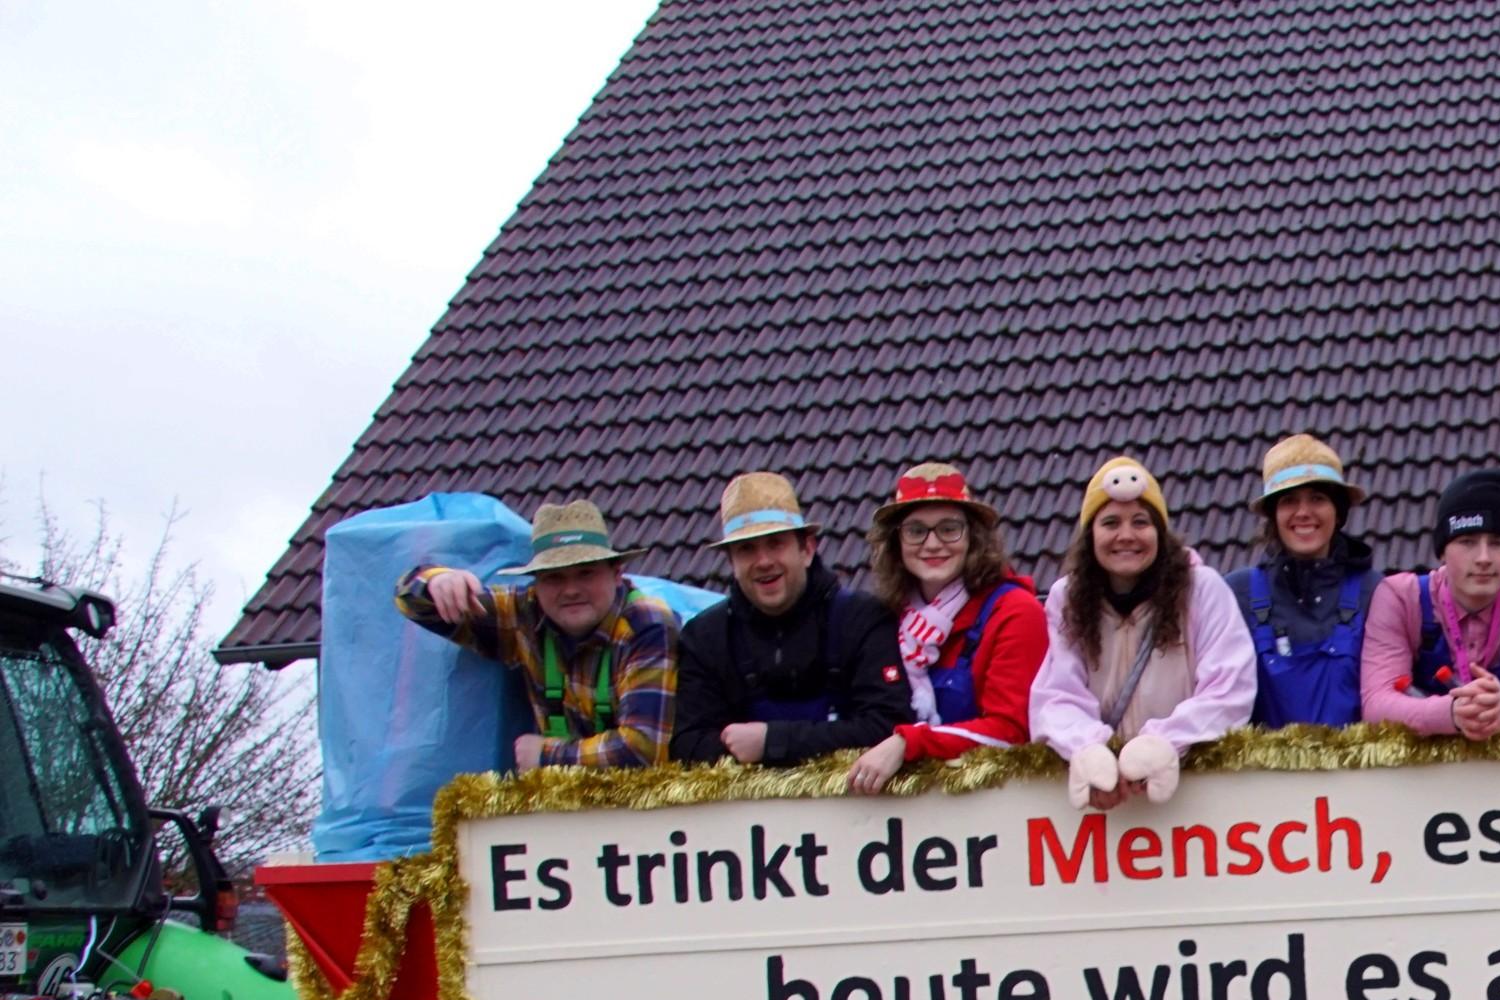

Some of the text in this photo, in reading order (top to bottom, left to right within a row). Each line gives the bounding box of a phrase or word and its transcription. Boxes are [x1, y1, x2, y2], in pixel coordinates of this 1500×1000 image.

[490, 843, 572, 912] Es
[596, 824, 830, 907] trinkt
[857, 817, 998, 895] der
[1027, 796, 1392, 887] Mensch,
